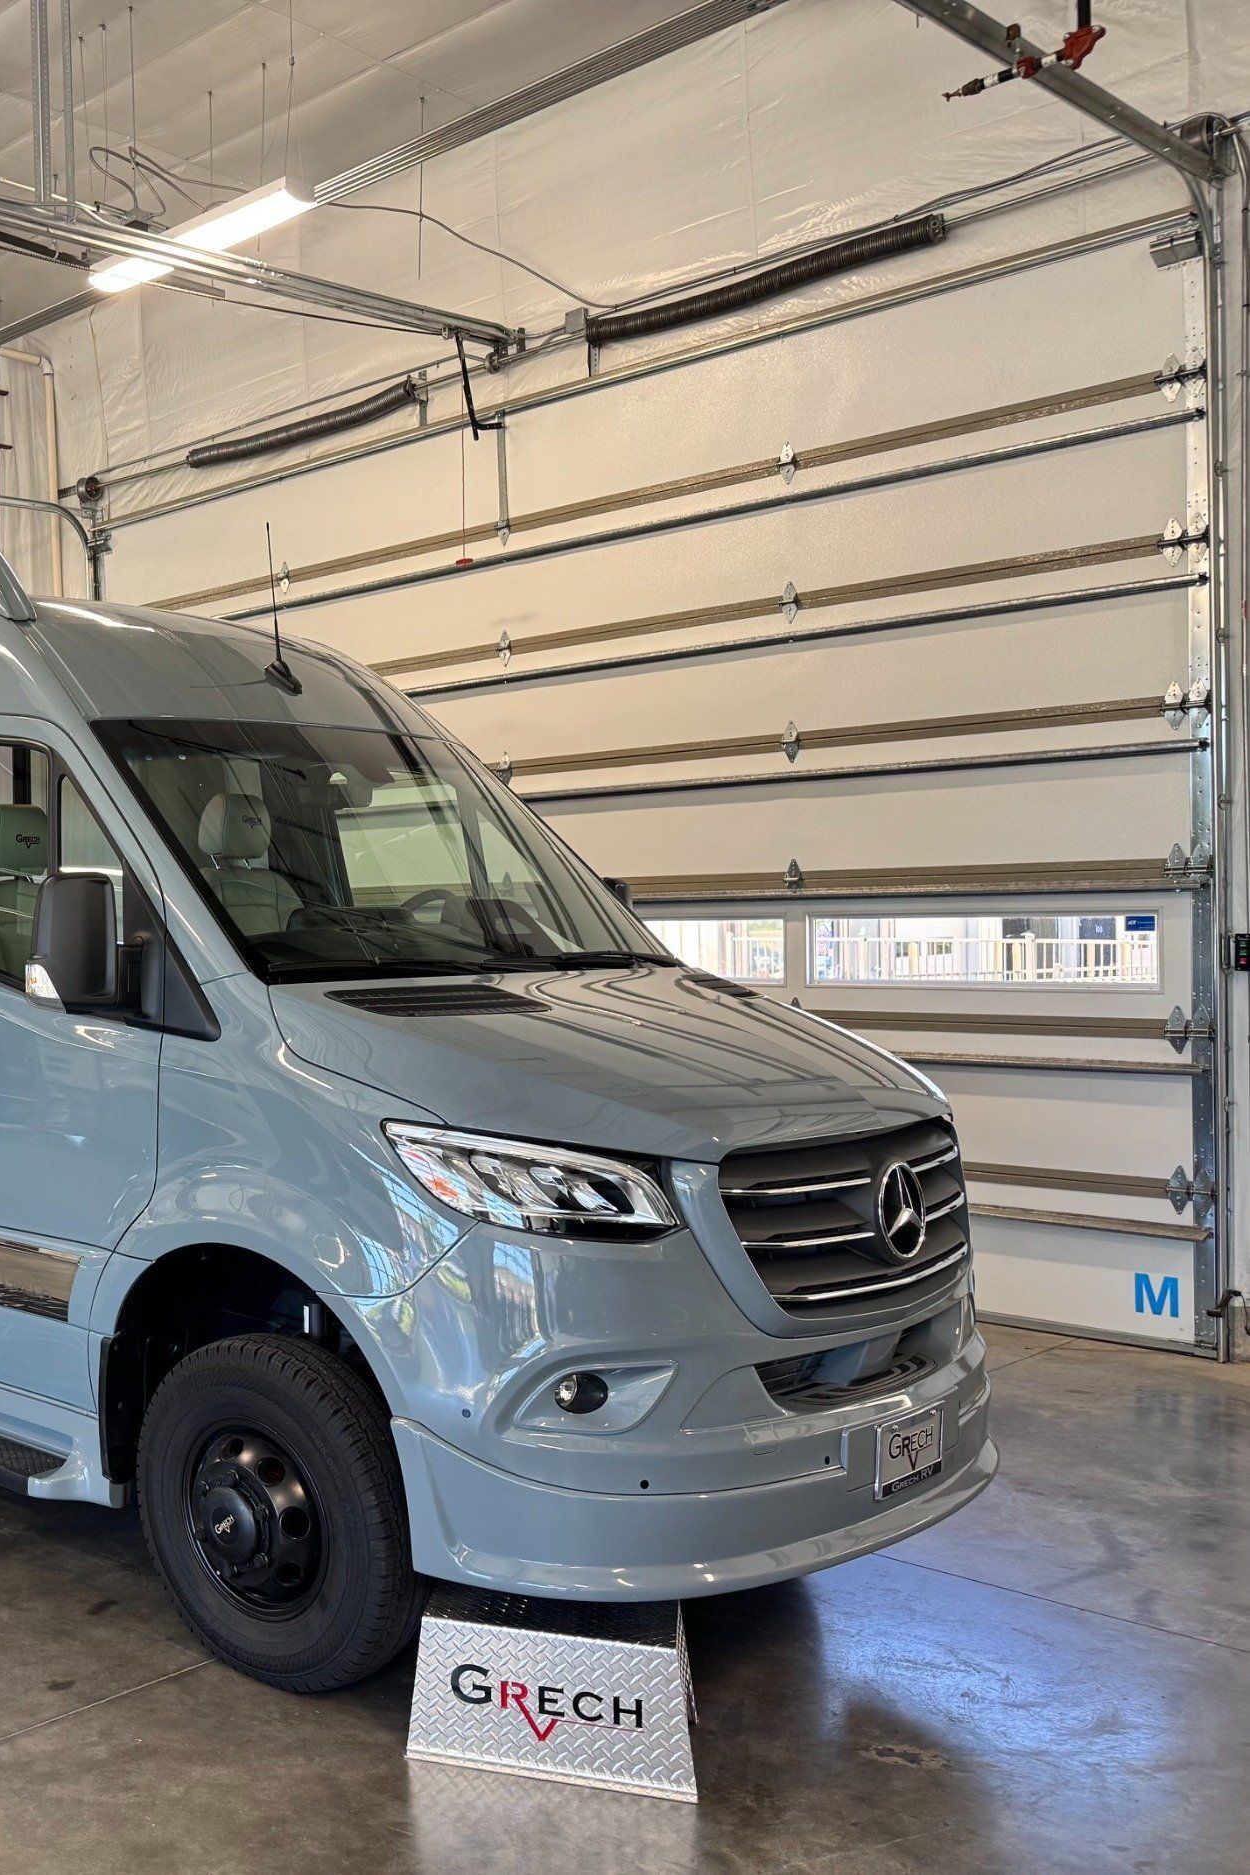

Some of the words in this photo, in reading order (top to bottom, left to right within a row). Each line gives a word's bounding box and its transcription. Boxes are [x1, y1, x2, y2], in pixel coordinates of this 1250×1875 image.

[15, 833, 41, 850] GRECH
[1134, 1272, 1179, 1318] M
[888, 1423, 934, 1471] GRECH
[891, 1473, 920, 1492] GRECH
[920, 1463, 935, 1480] RV
[214, 1514, 235, 1535] GRECH
[450, 1663, 645, 1742] GRECH
